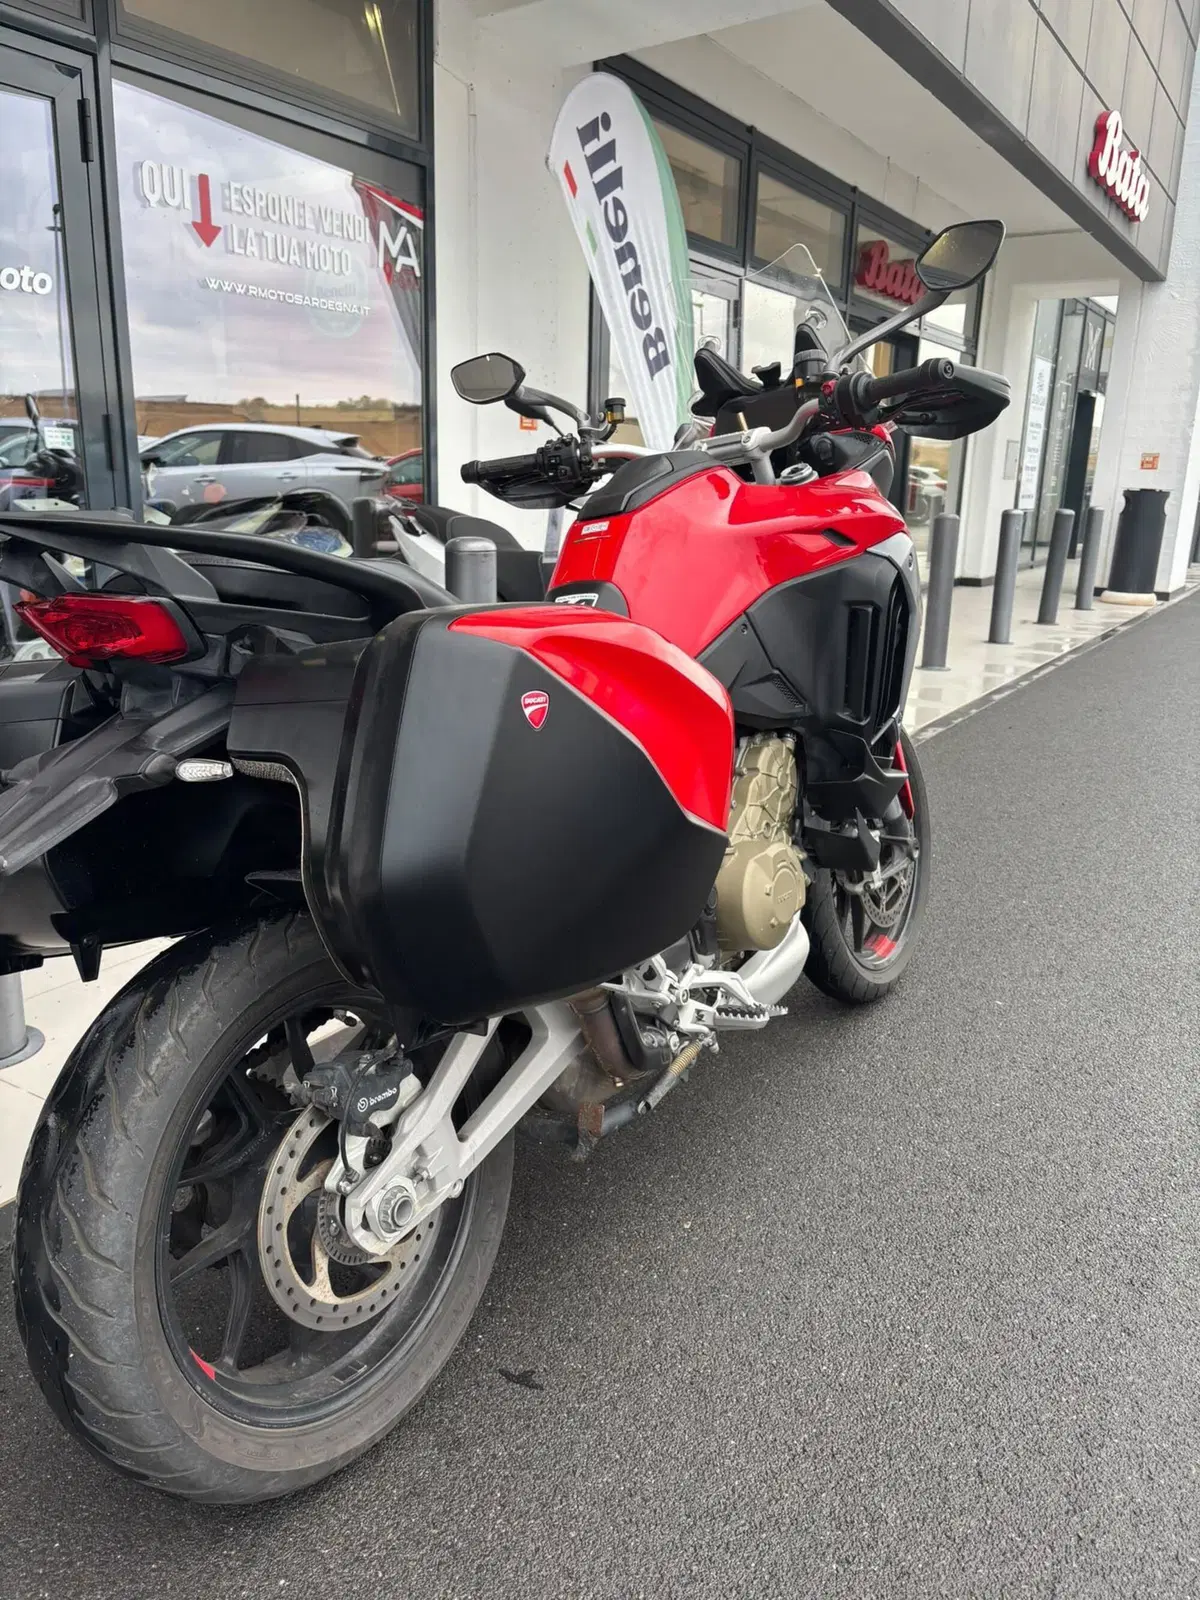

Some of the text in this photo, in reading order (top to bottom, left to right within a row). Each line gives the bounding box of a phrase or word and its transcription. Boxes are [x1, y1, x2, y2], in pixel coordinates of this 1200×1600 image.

[140, 159, 191, 210] QUI
[1097, 109, 1150, 222] Bata
[228, 180, 370, 243] ESPONI E VENDI
[231, 223, 350, 276] LA TUA MOTO
[576, 111, 670, 381] Benelli
[205, 276, 371, 316] WWW.RMOTOSARDEGNA.IT
[524, 696, 547, 705] DUCATI
[369, 1087, 398, 1106] brembo
